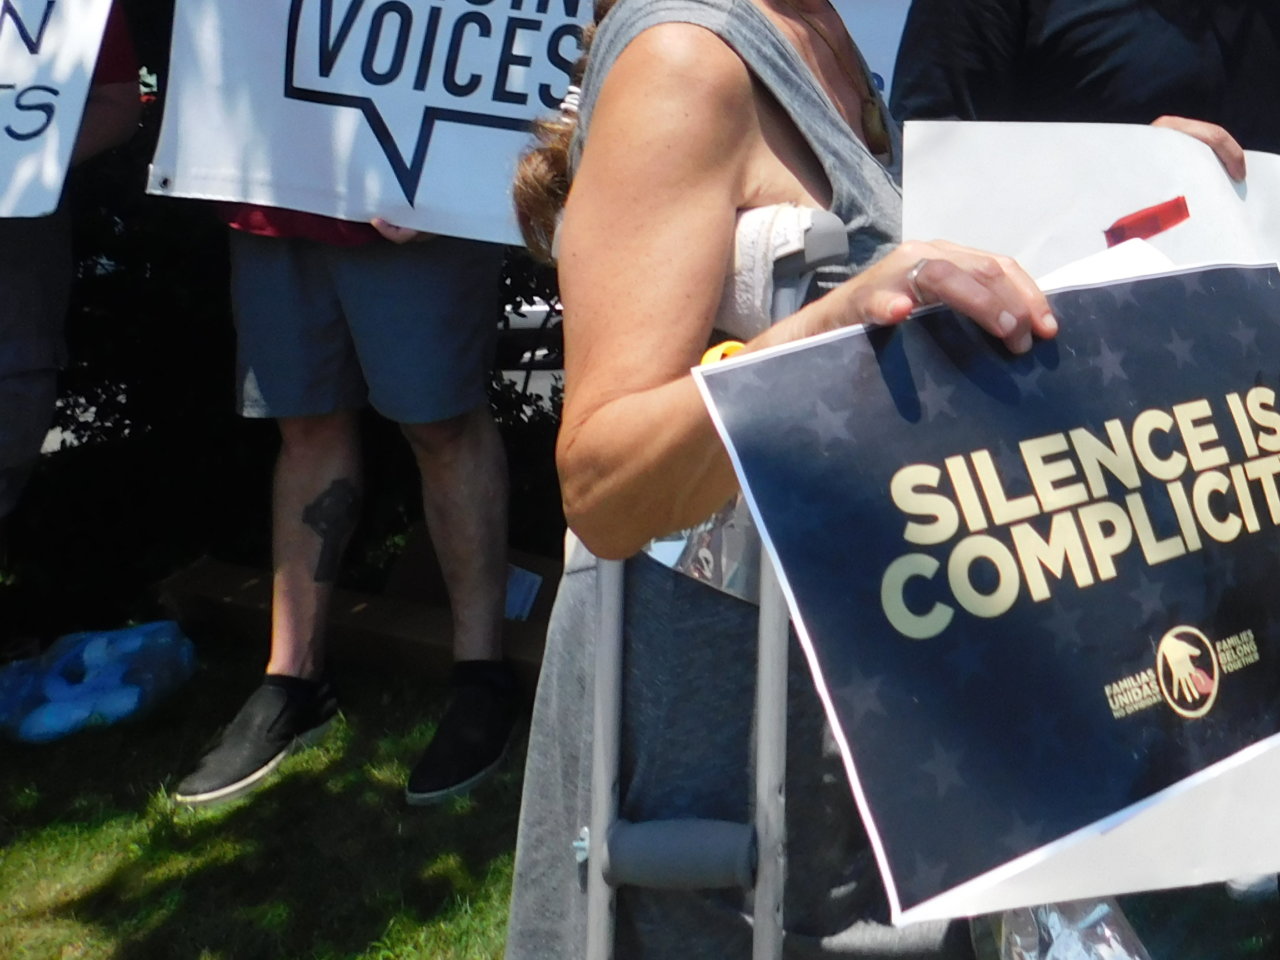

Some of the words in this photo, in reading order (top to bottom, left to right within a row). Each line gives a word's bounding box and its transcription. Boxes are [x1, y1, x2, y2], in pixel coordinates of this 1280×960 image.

[889, 398, 1230, 545] SILENCE
[1215, 629, 1254, 653] FAMILIES
[1218, 640, 1257, 666] BELONG
[1104, 667, 1156, 696] FAMILIAS
[1108, 681, 1160, 711] UNIDAS
